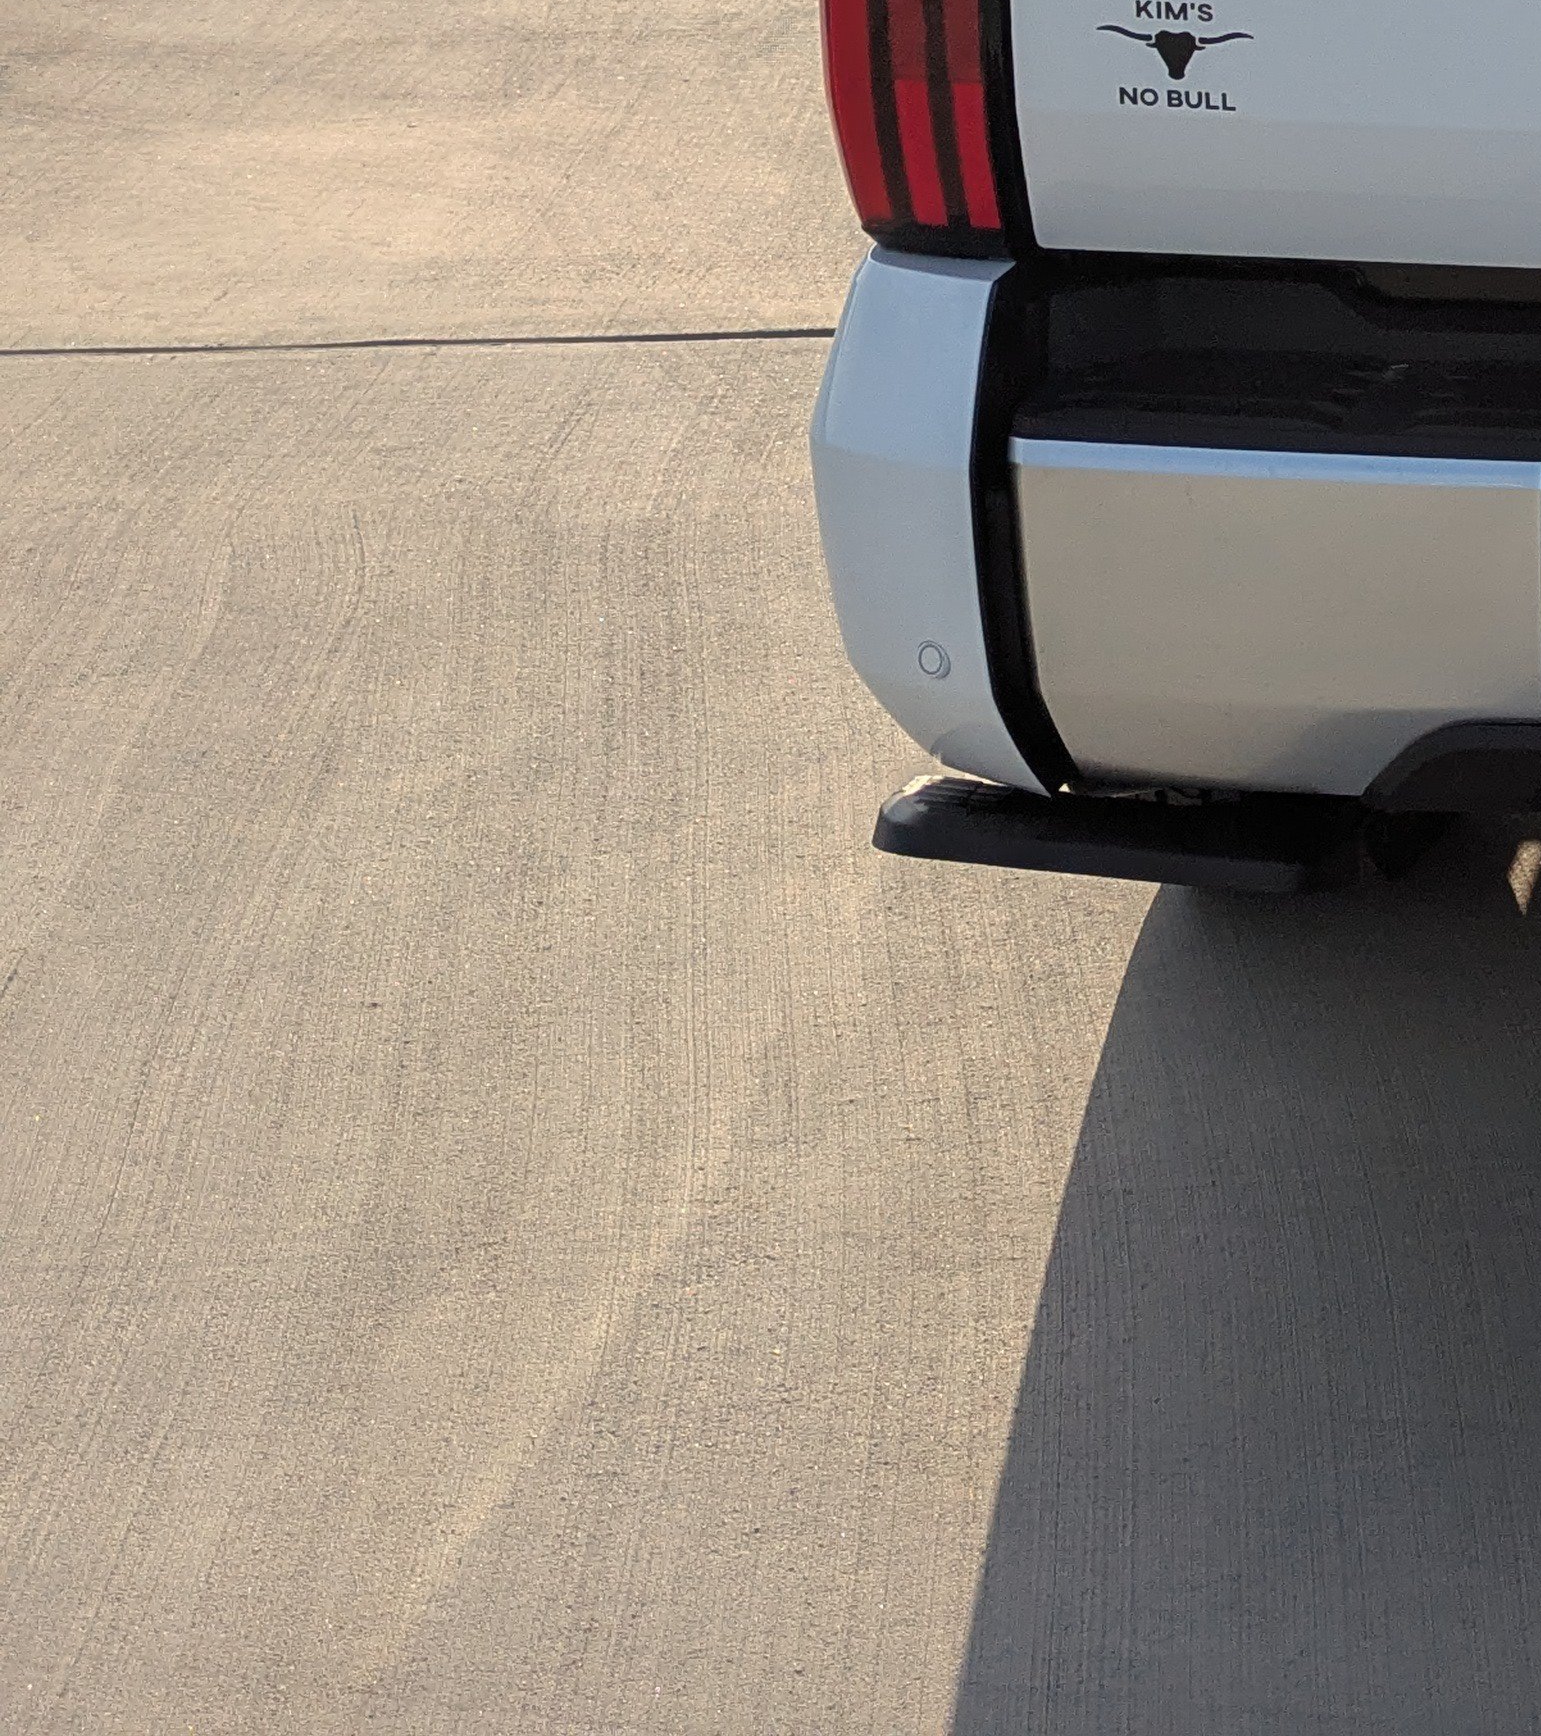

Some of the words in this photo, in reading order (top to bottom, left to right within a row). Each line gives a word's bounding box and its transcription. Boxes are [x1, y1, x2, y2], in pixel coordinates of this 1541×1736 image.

[1135, 0, 1214, 22] KIM'S
[1119, 87, 1159, 106] NO
[1167, 90, 1236, 112] BULL
